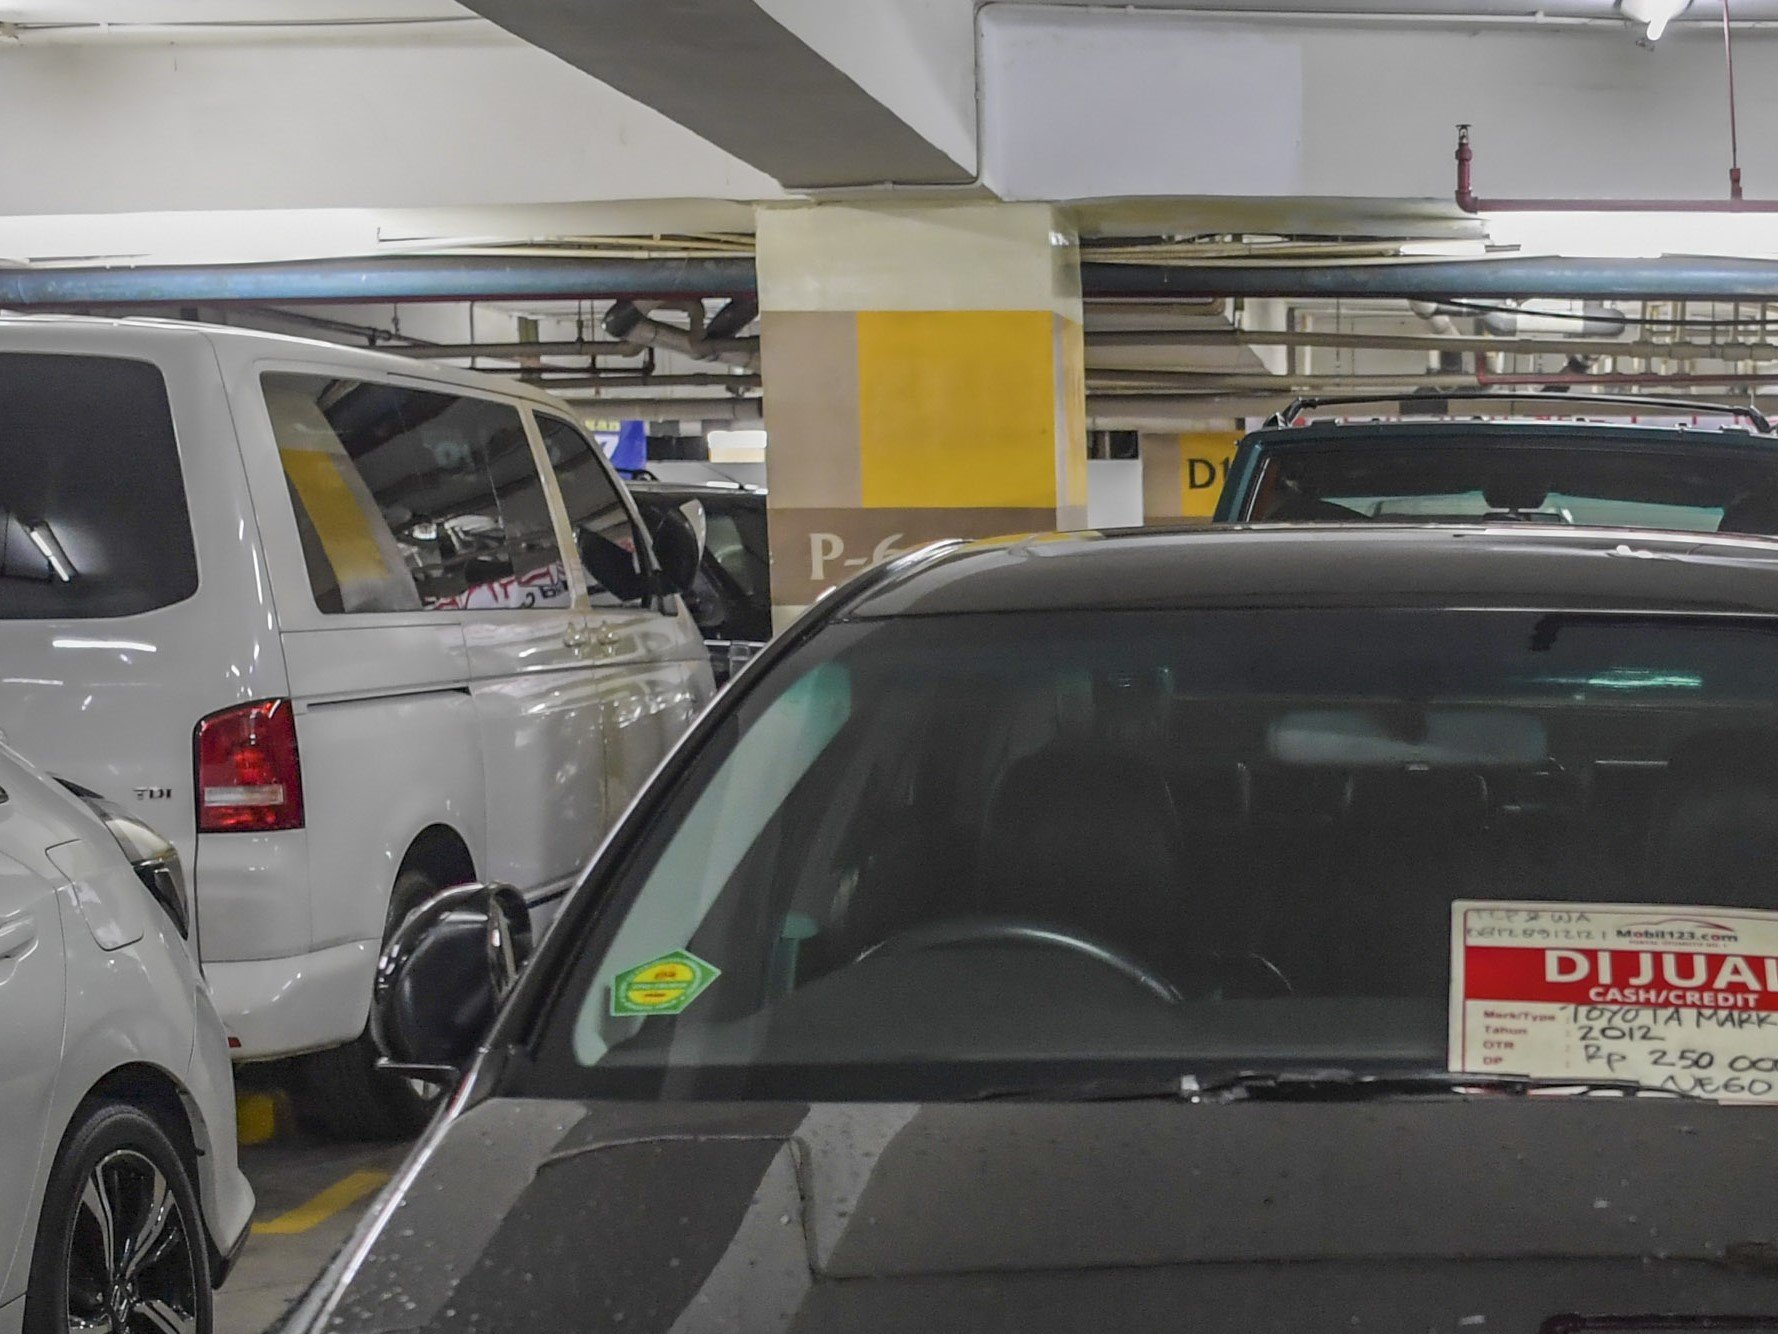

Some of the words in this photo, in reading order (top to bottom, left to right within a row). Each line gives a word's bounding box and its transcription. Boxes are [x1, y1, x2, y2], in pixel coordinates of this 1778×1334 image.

[1616, 929, 1738, 942] Mobil123.com
[1589, 987, 1760, 1008] CASH/CREDIT
[1560, 1004, 1682, 1028] TOYOTA
[1696, 1010, 1778, 1029] MARK
[1577, 1025, 1665, 1042] 2012
[1648, 1049, 1714, 1070] 250
